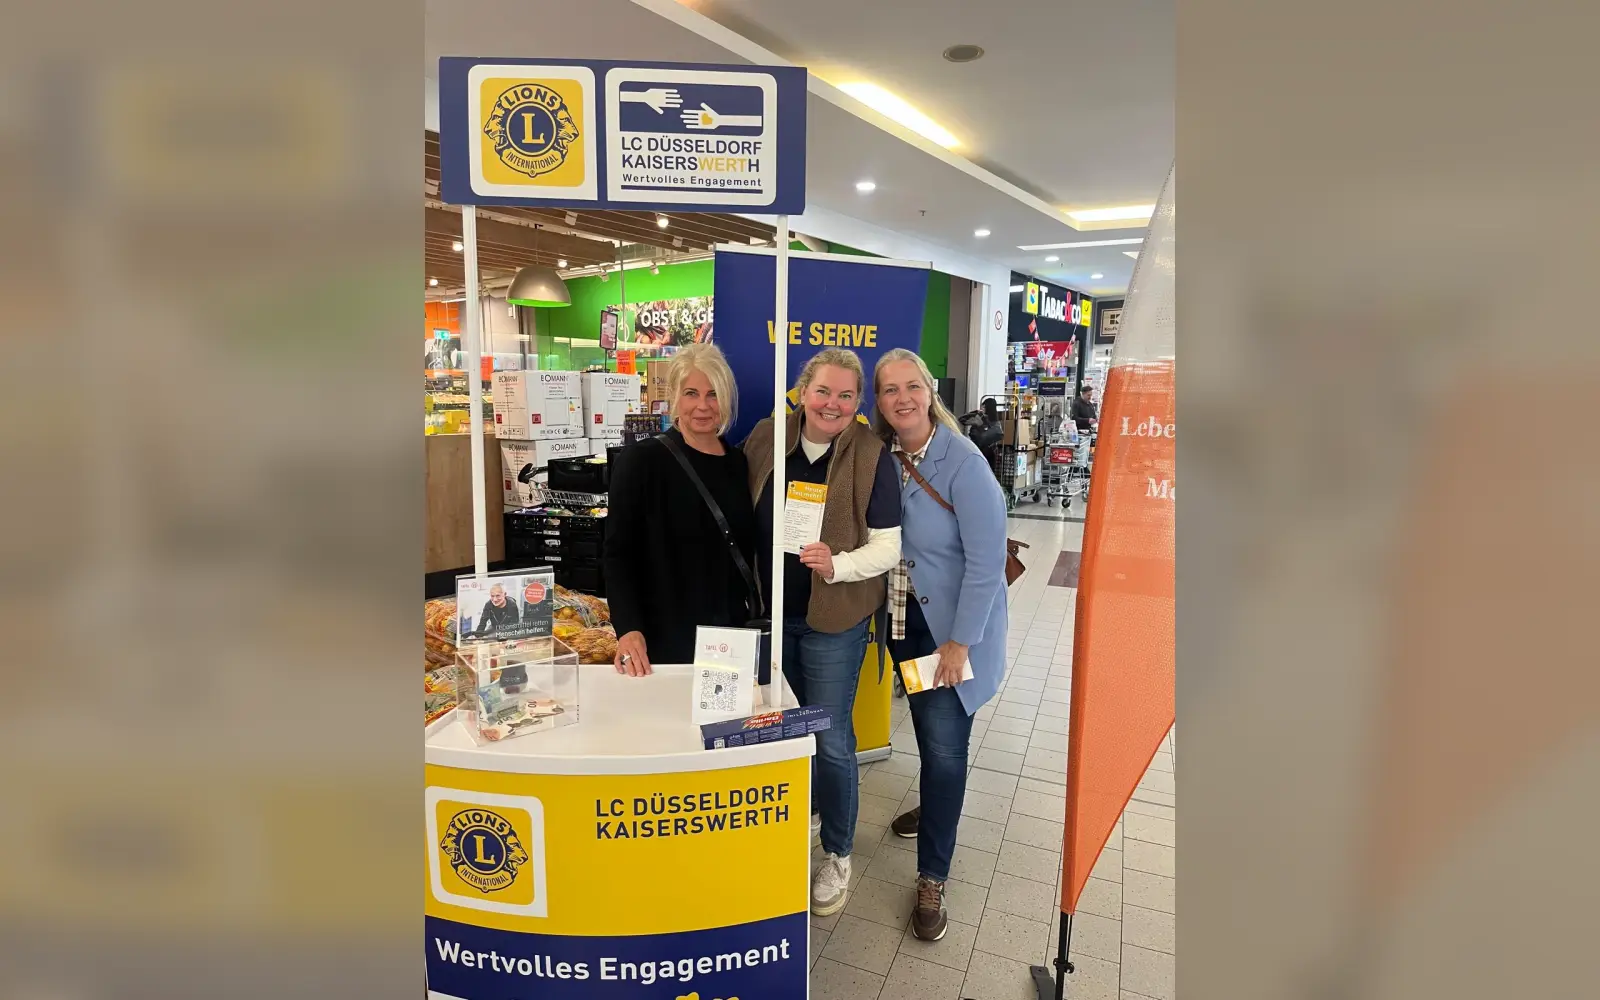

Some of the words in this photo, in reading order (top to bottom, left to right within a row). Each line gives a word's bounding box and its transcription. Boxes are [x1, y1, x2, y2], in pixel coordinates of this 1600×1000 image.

[504, 87, 557, 107] LIONS
[521, 113, 545, 144] L
[621, 136, 643, 152] LC
[648, 135, 762, 155] DÜSSELDORF
[505, 151, 559, 170] INTERNATIONAL
[621, 154, 760, 173] KAISERSWERTH
[622, 173, 686, 185] Wertvolles
[690, 175, 762, 188] Engagement
[640, 309, 677, 328] OBST
[681, 308, 693, 325] &
[809, 322, 878, 348] SERVE
[540, 374, 569, 382] BOMANN
[1119, 415, 1176, 439] Lebe
[495, 629, 525, 638] Menschen
[596, 798, 624, 818] LC
[633, 782, 790, 816] DÜSSELDORF
[457, 812, 507, 833] LIONS
[596, 804, 790, 840] KAISERSWERTH
[473, 834, 496, 865] L
[460, 868, 509, 887] INTERNATIONAL
[435, 937, 590, 980] Wertvolles
[600, 938, 790, 985] Engagement
